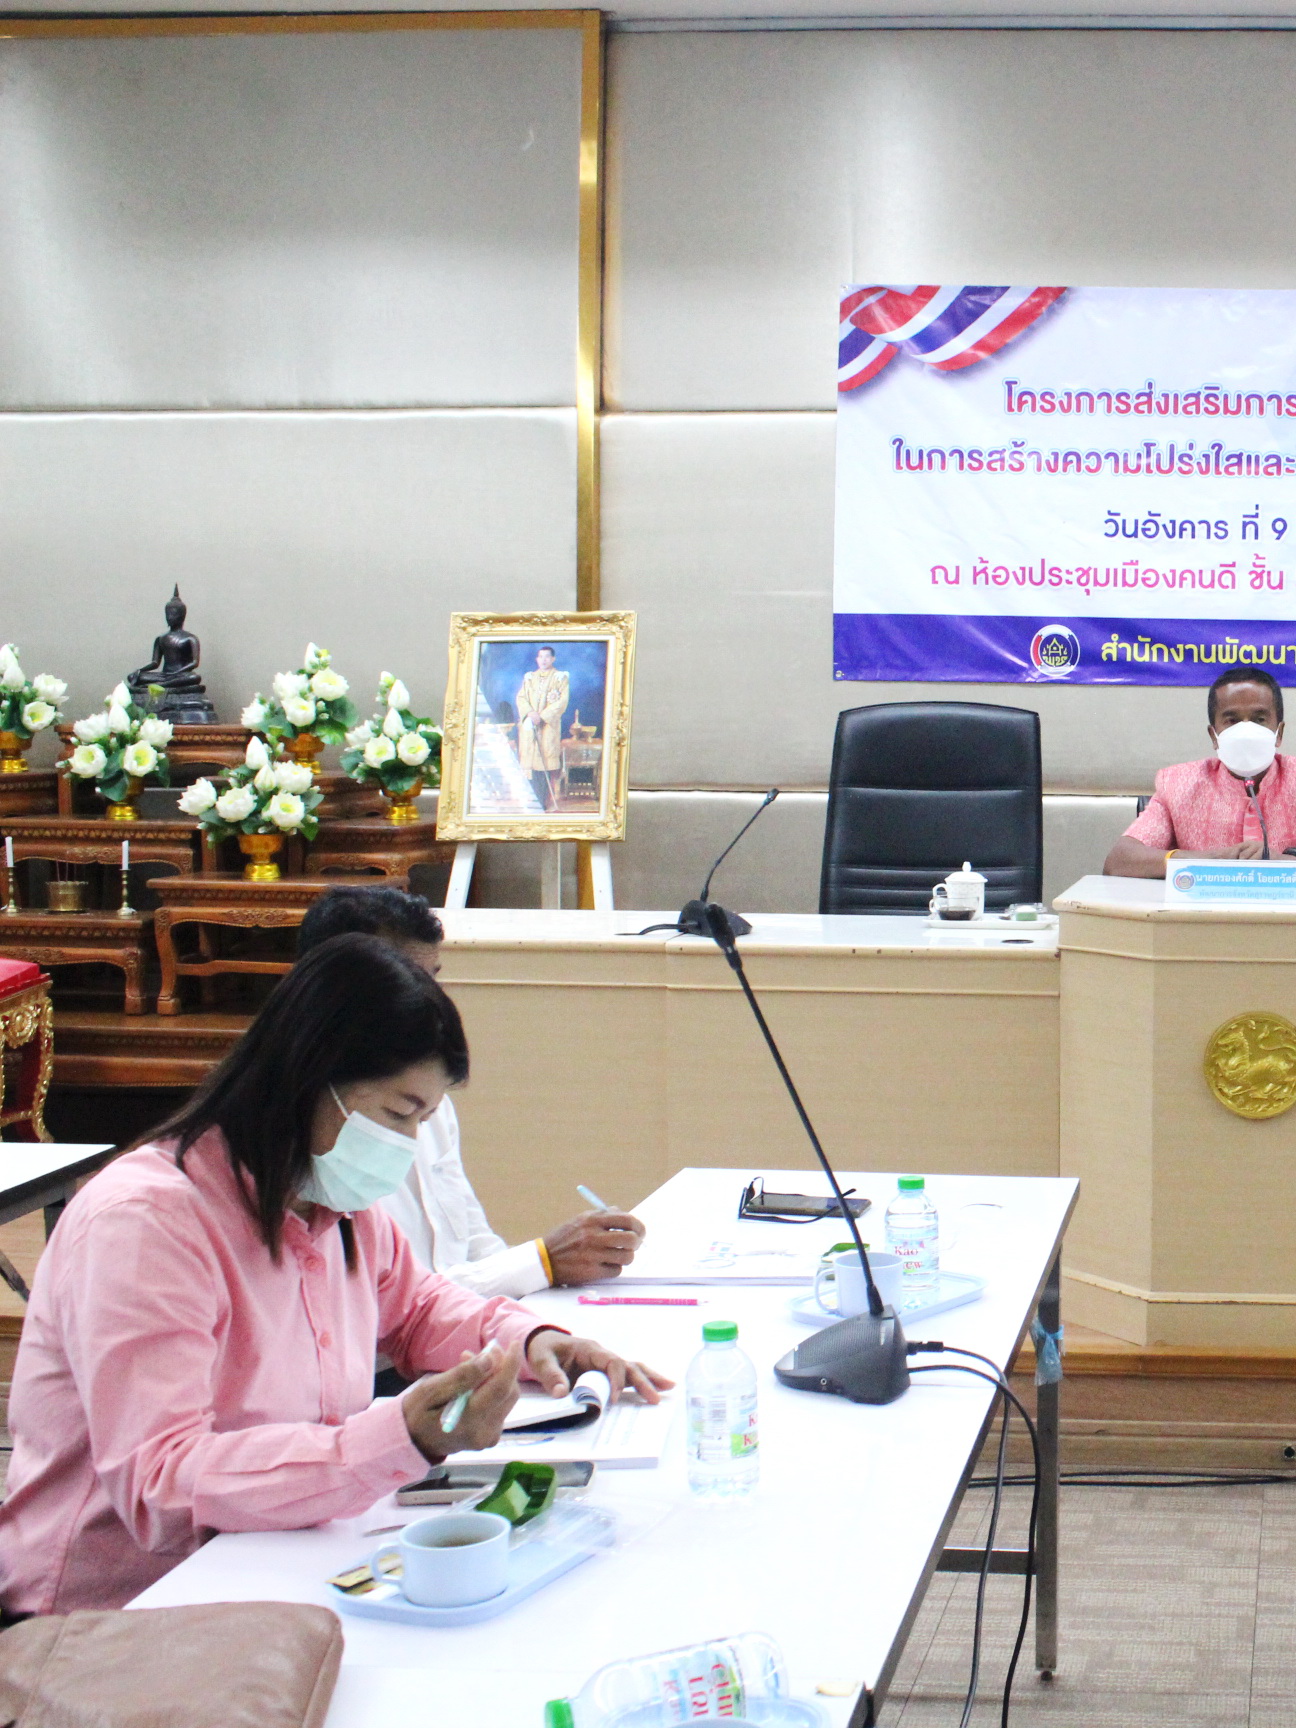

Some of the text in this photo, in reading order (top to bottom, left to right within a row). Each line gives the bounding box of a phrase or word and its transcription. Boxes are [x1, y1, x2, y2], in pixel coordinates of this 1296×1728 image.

[1103, 510, 1229, 540] วันอังคาร
[1241, 504, 1259, 540] ที่
[1271, 517, 1288, 541] 9
[930, 564, 960, 586] ณ
[972, 557, 1237, 596] ห้องประชุมเมืองคนดี
[1247, 553, 1284, 591] ชั้น
